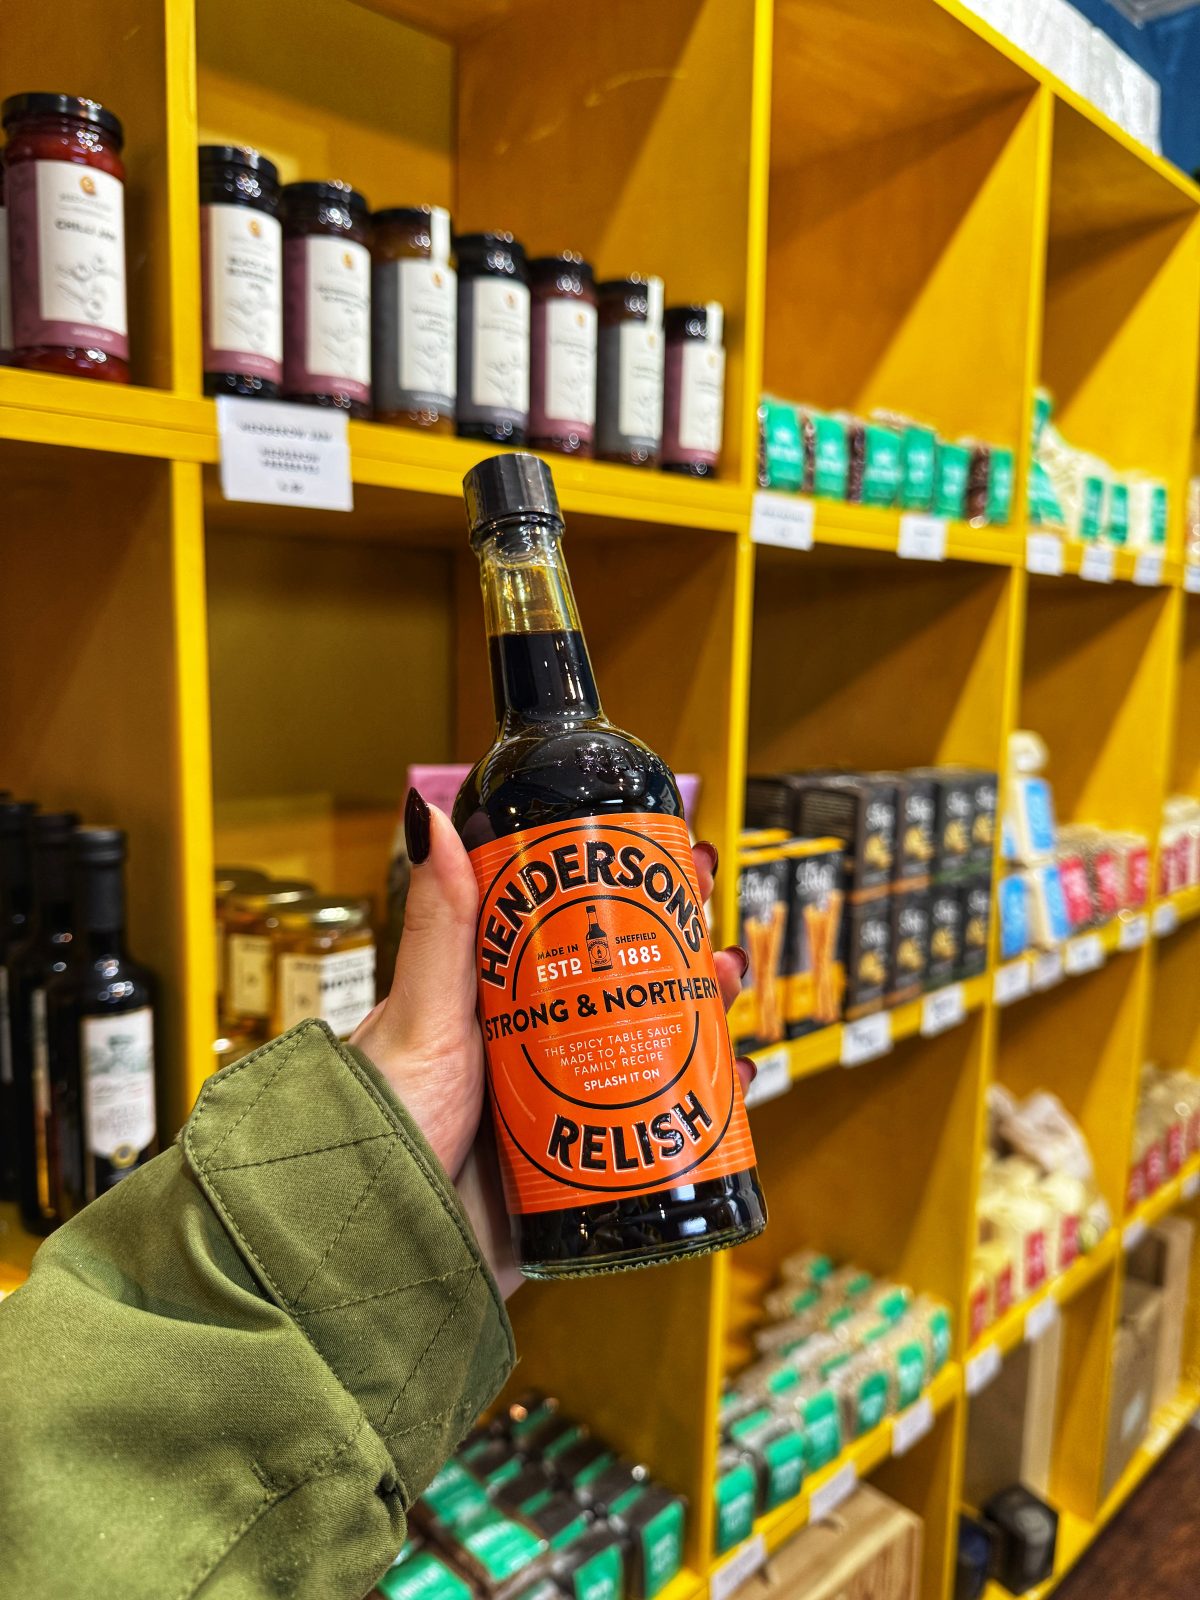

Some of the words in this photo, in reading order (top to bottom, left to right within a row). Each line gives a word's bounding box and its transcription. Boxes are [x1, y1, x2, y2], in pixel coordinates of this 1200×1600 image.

[615, 932, 657, 944] SHEFFIELD
[537, 948, 564, 960] MADE
[567, 944, 579, 954] IN
[618, 945, 662, 967] 1885
[536, 957, 582, 983] ESTD
[486, 999, 569, 1042] STRONG
[577, 993, 598, 1018] &
[604, 977, 718, 1013] NORTHERN
[545, 1045, 565, 1057] THE
[569, 1037, 604, 1052] SPICY
[608, 1030, 643, 1046] TABLE
[647, 1023, 682, 1038] SAUCE
[560, 1052, 593, 1067] MADE
[598, 1048, 614, 1058] TO
[618, 1045, 627, 1055] A
[631, 1038, 673, 1052] SECRET
[574, 1060, 617, 1076] FAMILY
[622, 1052, 664, 1067] RECIPE
[583, 1074, 628, 1092] SPLASH
[629, 1072, 640, 1083] IT
[642, 1068, 660, 1080] ON
[546, 1091, 711, 1173] RELISH
